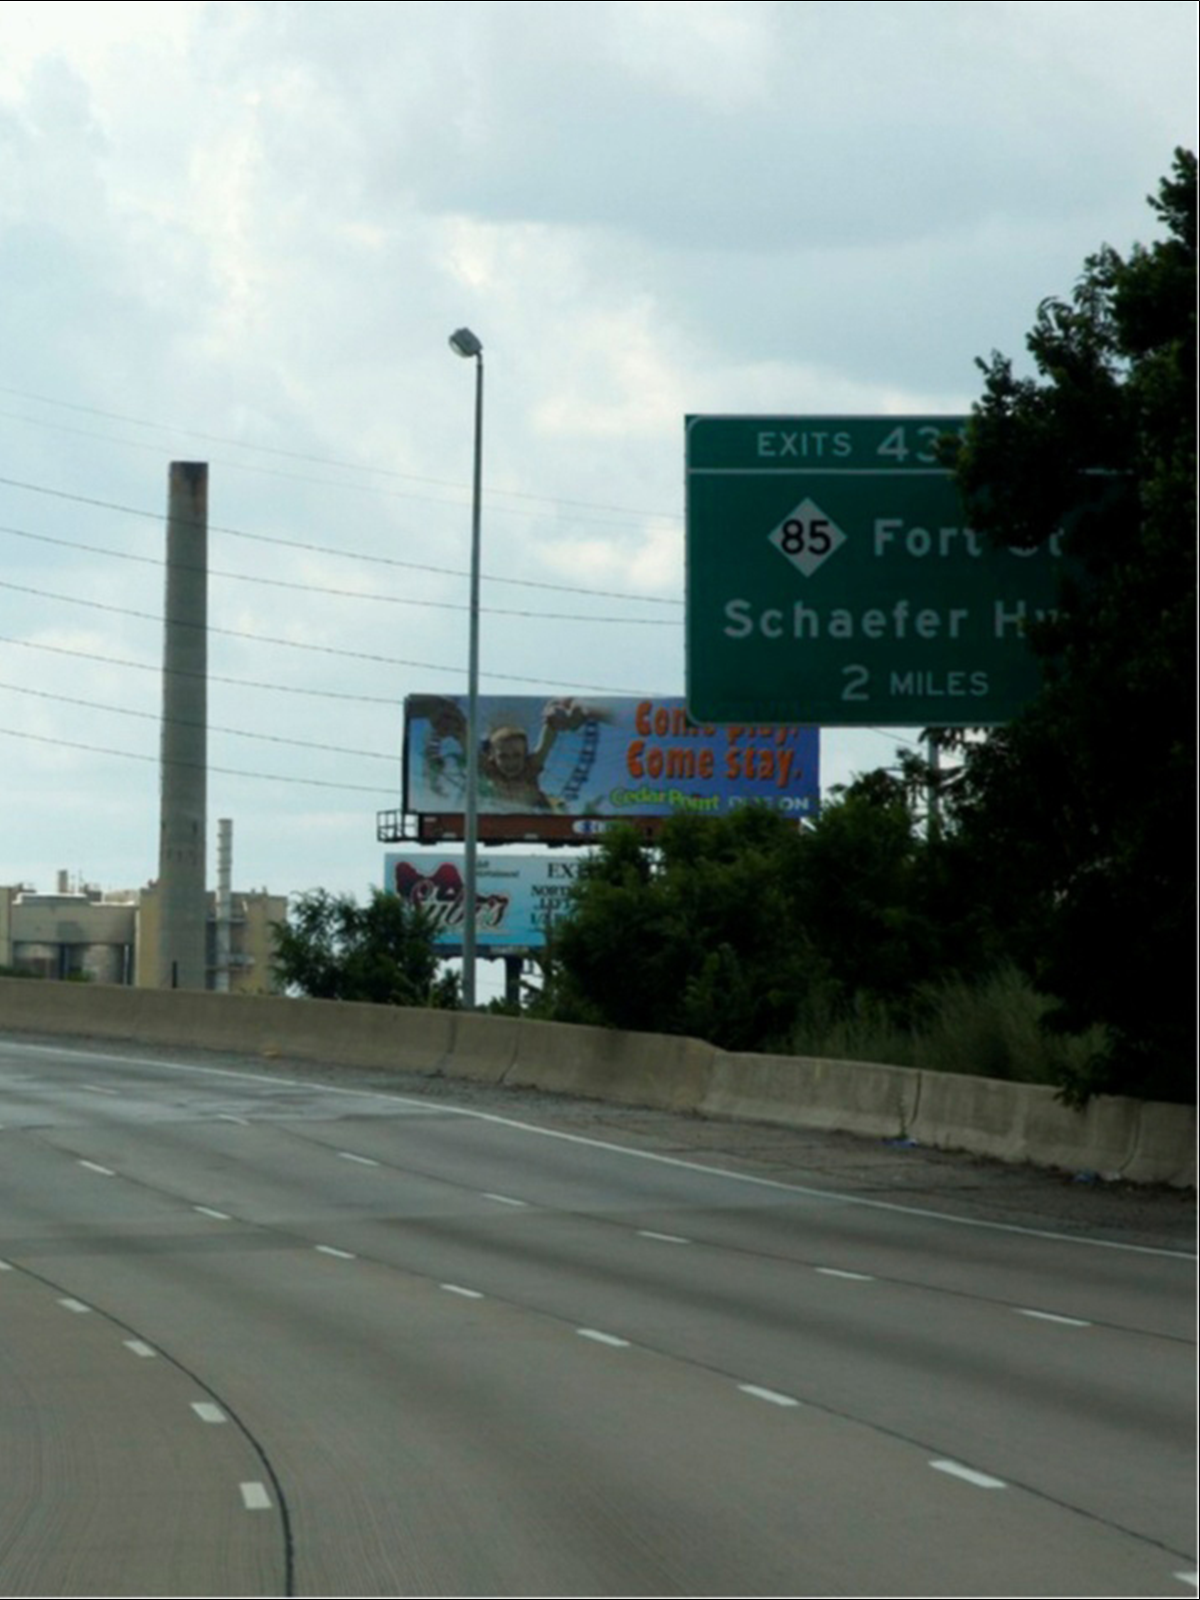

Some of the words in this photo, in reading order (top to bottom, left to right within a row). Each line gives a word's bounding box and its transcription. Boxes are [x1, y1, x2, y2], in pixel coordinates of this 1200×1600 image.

[757, 431, 853, 458] EXITS
[781, 519, 832, 556] 85
[872, 517, 983, 558] Fort
[723, 598, 970, 639] Schaefer
[841, 663, 871, 702] 2
[890, 670, 990, 697] MILES
[626, 740, 714, 779] Come
[726, 745, 803, 788] stay.
